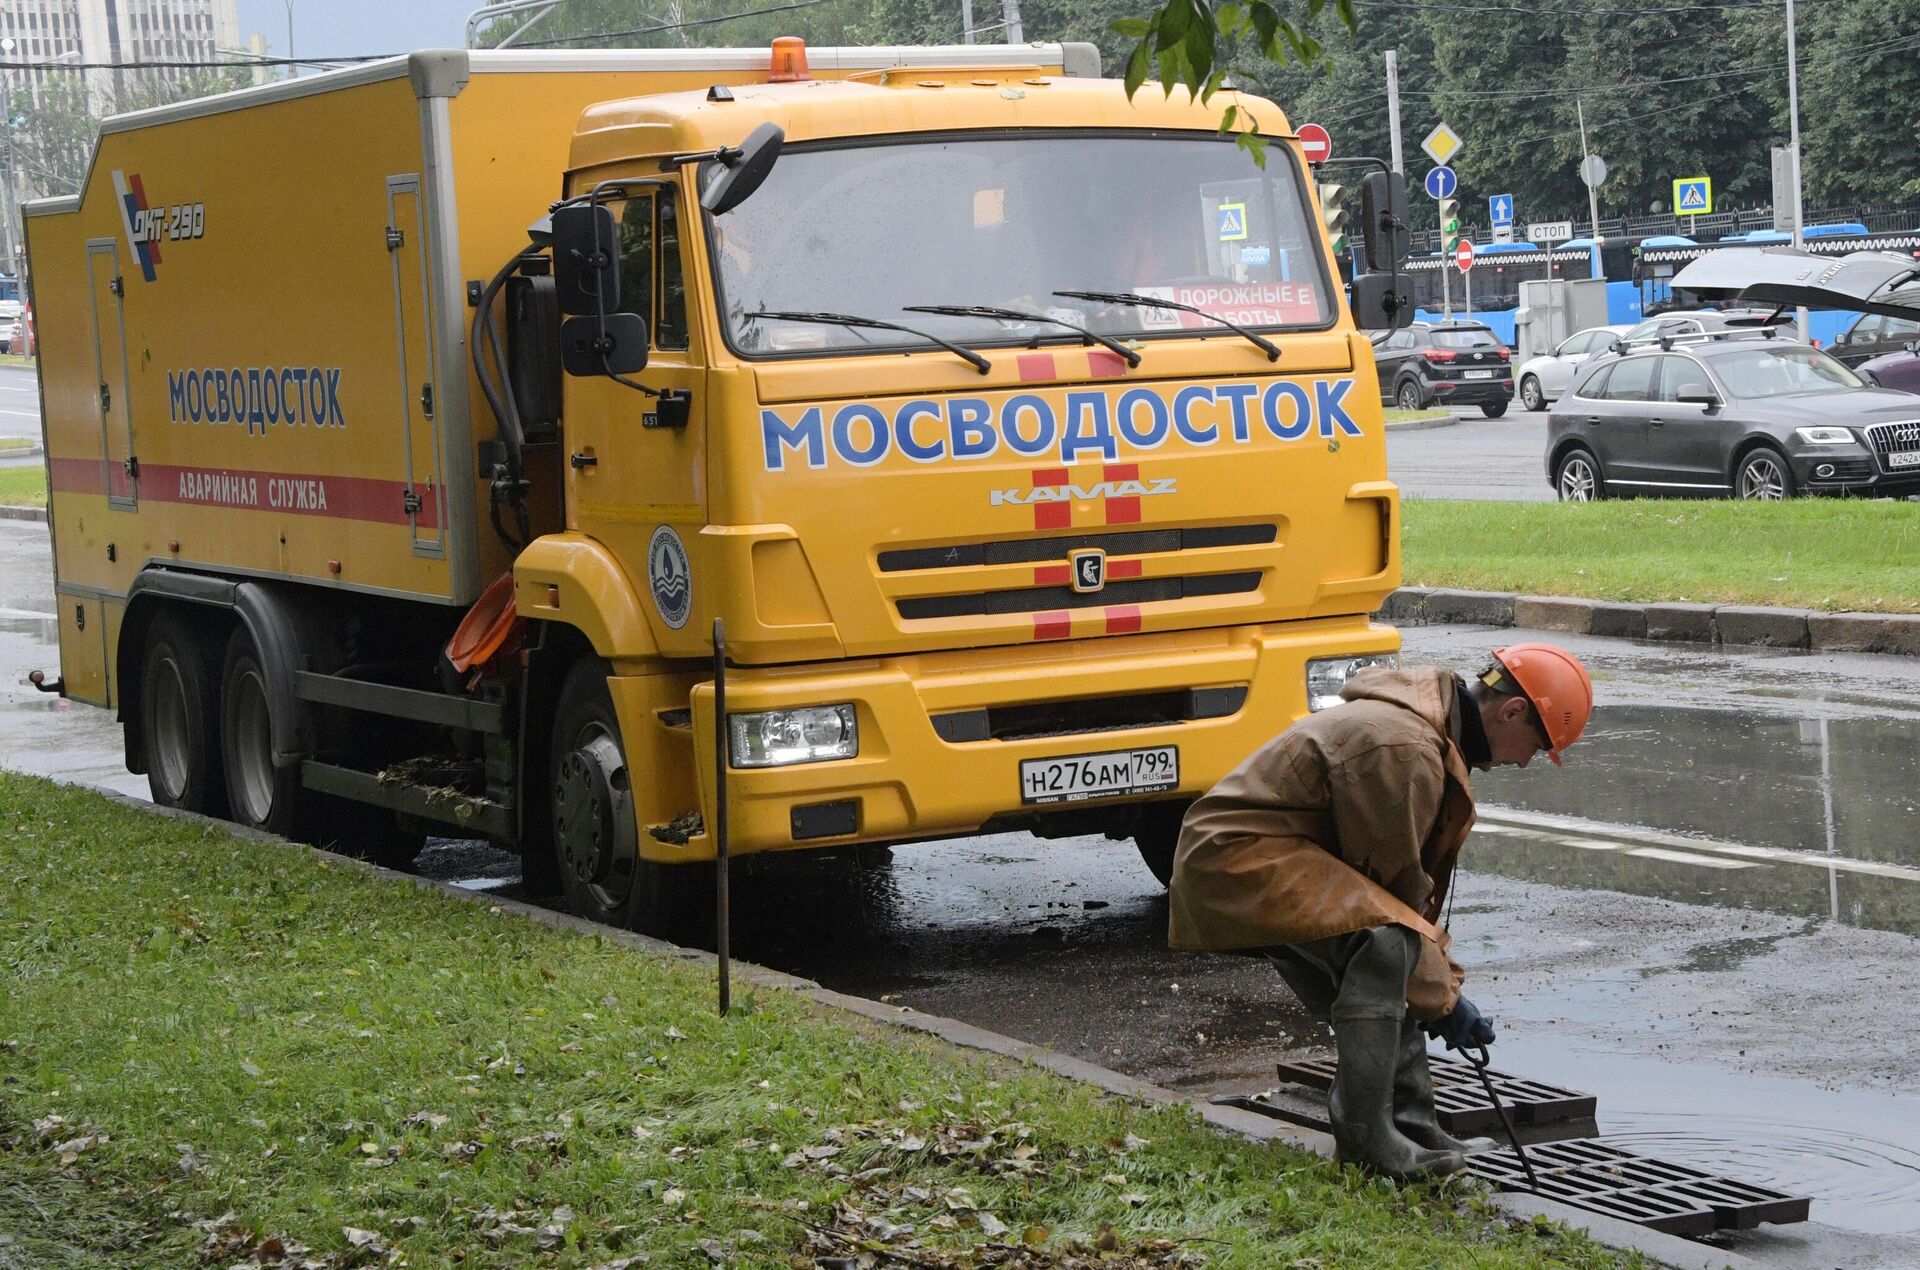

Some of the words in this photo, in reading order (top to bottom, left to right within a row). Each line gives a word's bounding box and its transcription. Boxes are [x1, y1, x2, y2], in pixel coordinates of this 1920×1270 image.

[1534, 225, 1566, 238] СТОП
[1180, 285, 1293, 306] ДОРОЖНЫЕ
[168, 367, 346, 437] МОСВОДОСТОК
[760, 378, 1364, 472] МОСВОДОСТОК
[1891, 452, 1920, 465] Х242А
[179, 471, 258, 506] АВАРИЙНАЯ
[268, 478, 328, 510] СЛУЖБА
[990, 478, 1178, 506] KAMAZ
[1032, 760, 1130, 793] Н276АМ
[1133, 751, 1169, 774] 799
[1142, 773, 1161, 782] RUS
